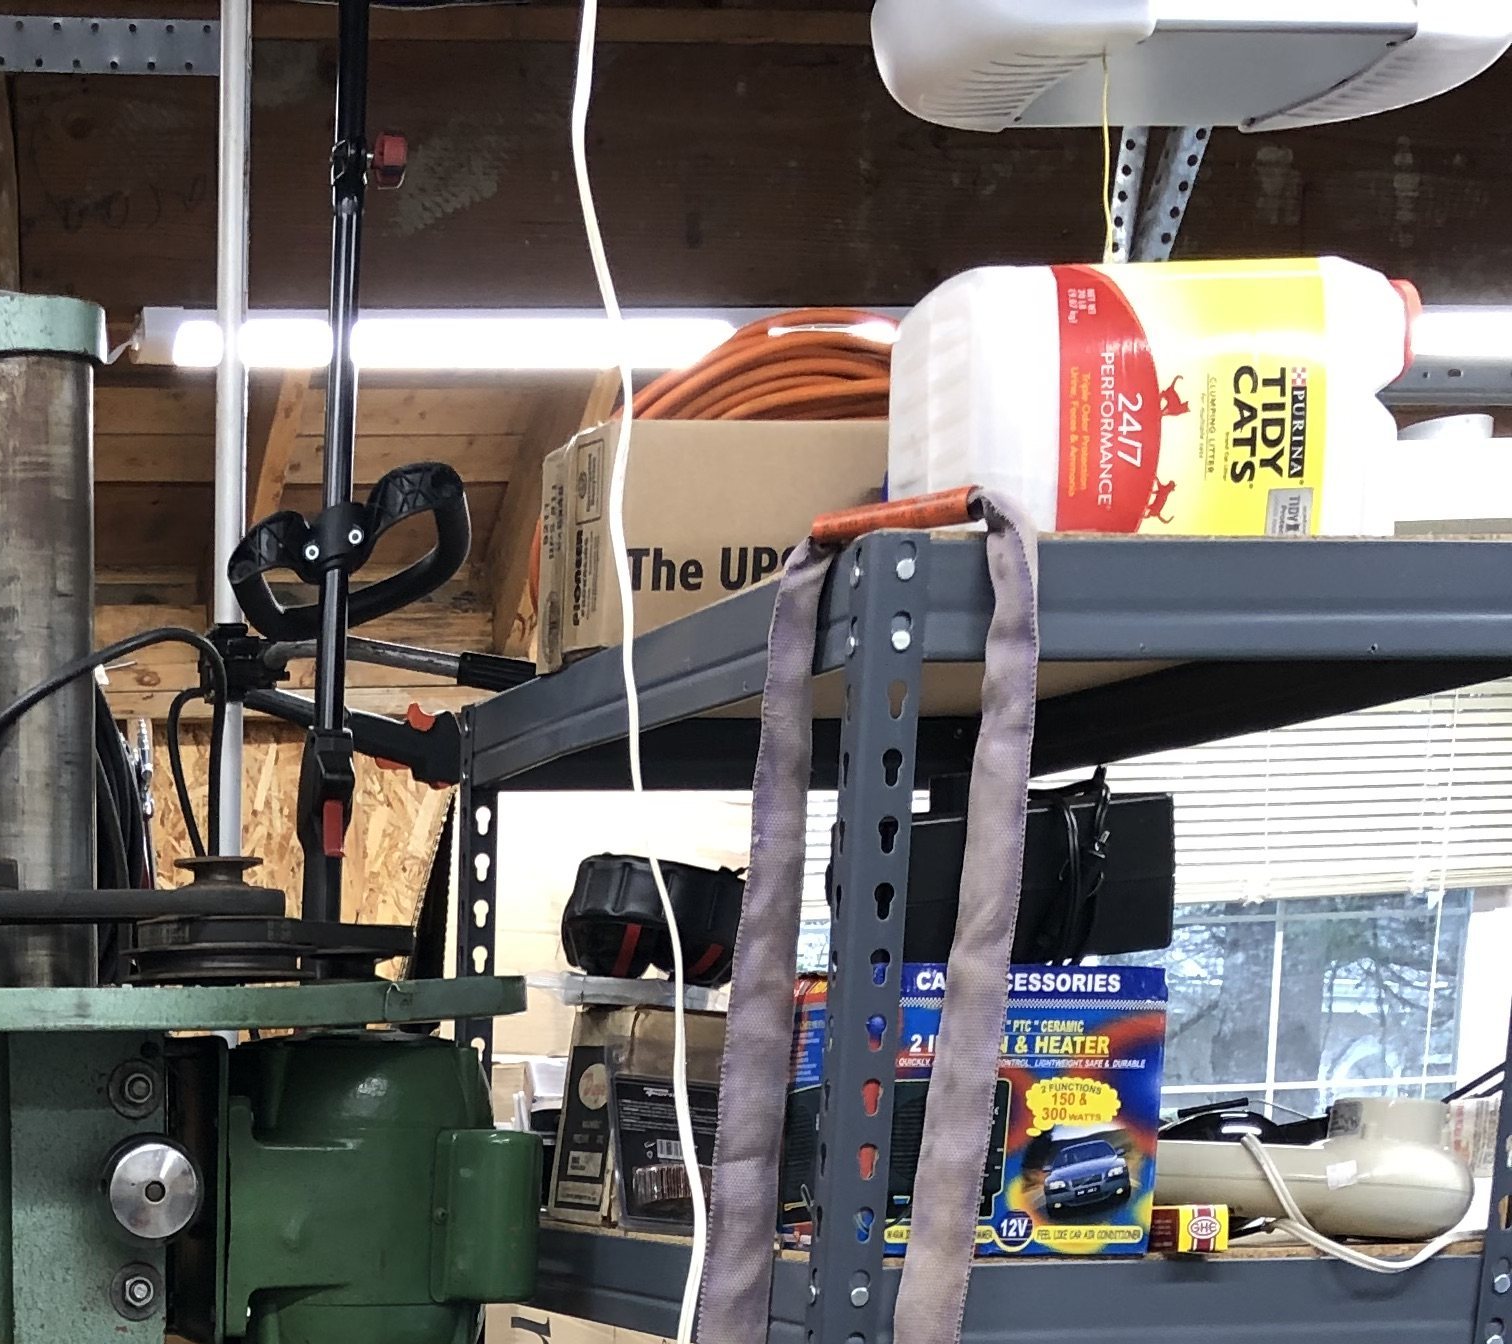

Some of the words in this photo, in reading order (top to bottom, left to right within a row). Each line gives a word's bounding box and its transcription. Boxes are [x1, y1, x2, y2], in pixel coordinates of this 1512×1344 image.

[1078, 289, 1086, 299] 20
[1069, 400, 1078, 431] Feces
[1081, 403, 1090, 432] Odor
[1098, 352, 1115, 505] PERFORMANCE
[1117, 393, 1143, 467] 24/7
[1231, 365, 1258, 483] CATS
[1259, 367, 1286, 478] TIDY
[1289, 390, 1305, 475] PURINA
[1068, 446, 1077, 496] Ammonia
[1080, 435, 1089, 490] Protection
[1207, 439, 1216, 473] LITTER
[573, 530, 583, 626] PIONEER
[626, 547, 703, 592] The
[1041, 1020, 1084, 1033] CERAMIC
[909, 1034, 922, 1053] 2
[1014, 1036, 1028, 1054] &
[1035, 1036, 1110, 1054] HEATER
[1085, 1059, 1103, 1068] SAFE
[1112, 1059, 1146, 1068] DURABLE
[1041, 1085, 1047, 1094] 2
[1048, 1083, 1102, 1096] FUNCTIONS
[1052, 1093, 1076, 1106] 150
[1079, 1093, 1088, 1106] &
[1041, 1107, 1067, 1121] 300
[1069, 1113, 1101, 1122] WATTS
[1000, 1218, 1029, 1239] 12V
[1053, 1229, 1067, 1240] LIKE
[1069, 1230, 1082, 1240] CAR
[1084, 1230, 1095, 1240] AIR
[1097, 1230, 1140, 1240] CONDITIONER
